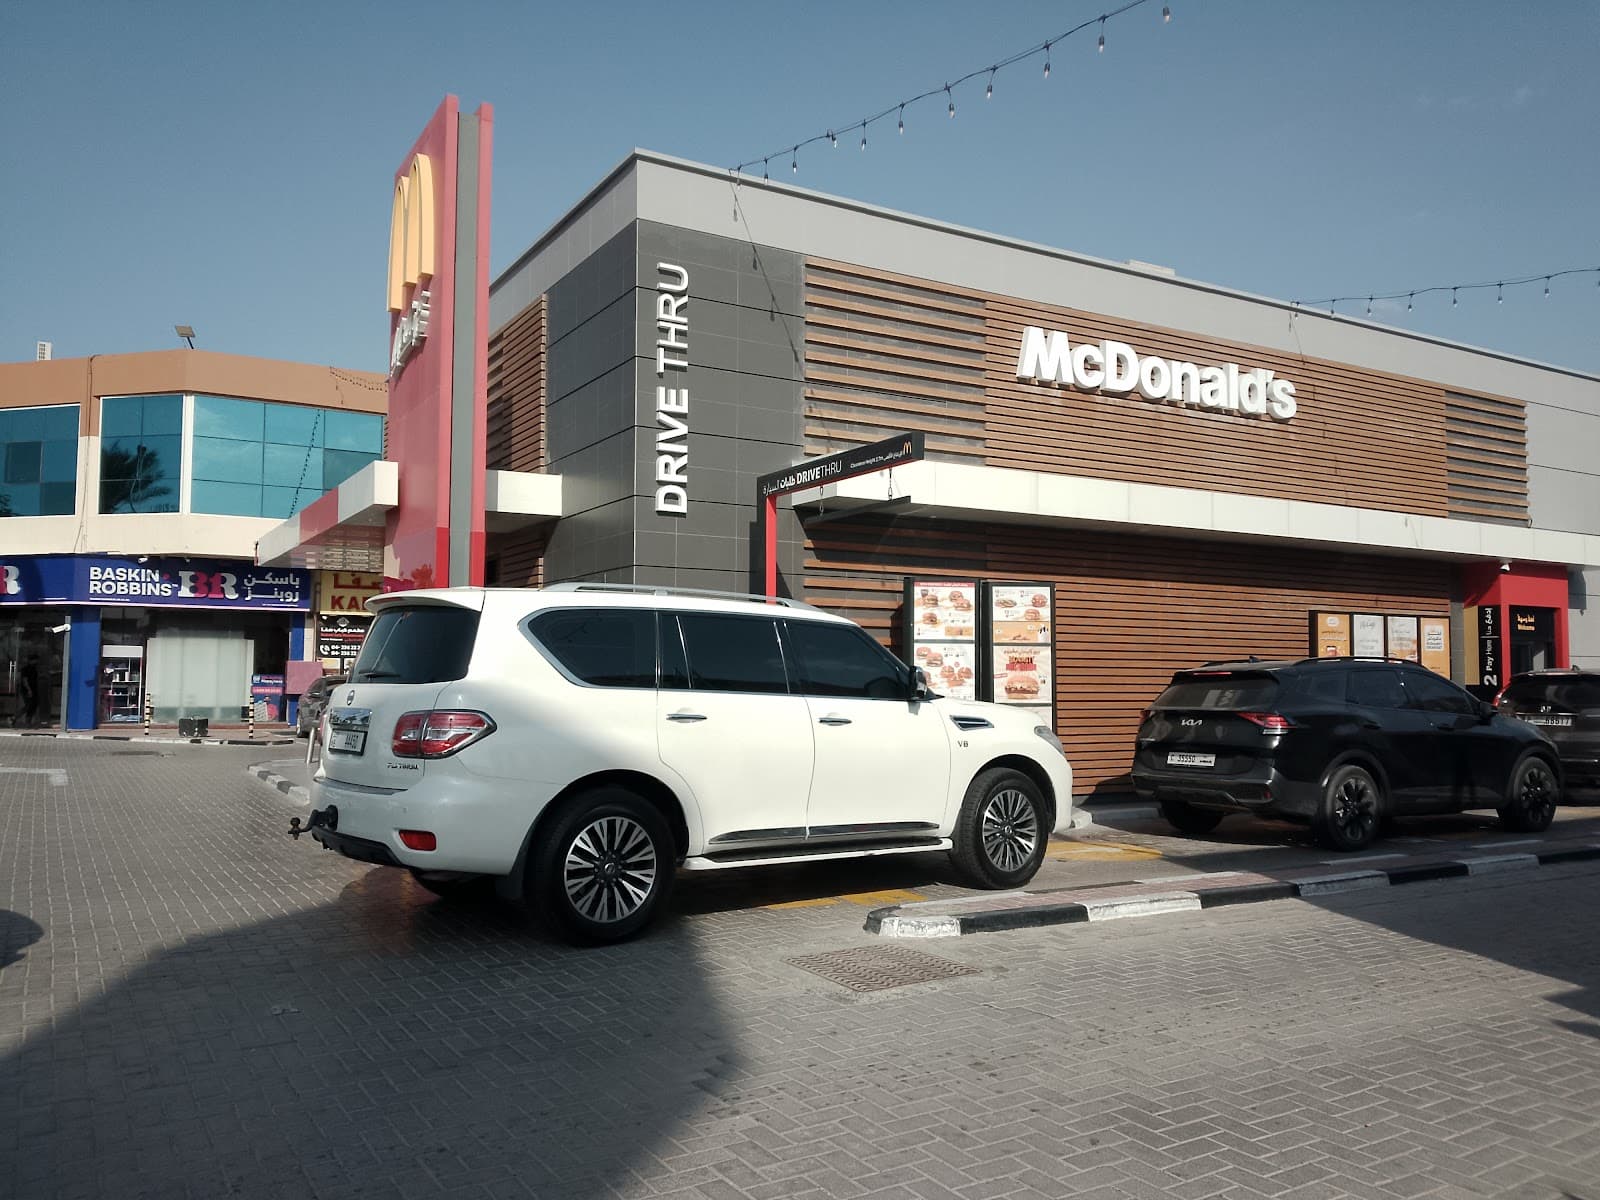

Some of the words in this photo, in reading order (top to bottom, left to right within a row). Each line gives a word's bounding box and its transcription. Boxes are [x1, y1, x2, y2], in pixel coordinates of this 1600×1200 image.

[656, 262, 688, 374] THRU
[1016, 326, 1297, 419] McDonald's
[656, 386, 688, 514] DRIVE
[89, 566, 160, 582] BASKIN
[243, 572, 300, 589] باسكن
[89, 582, 172, 597] ROBBINS
[1485, 657, 1494, 671] Pay
[1483, 674, 1498, 686] 2
[957, 740, 969, 748] V8
